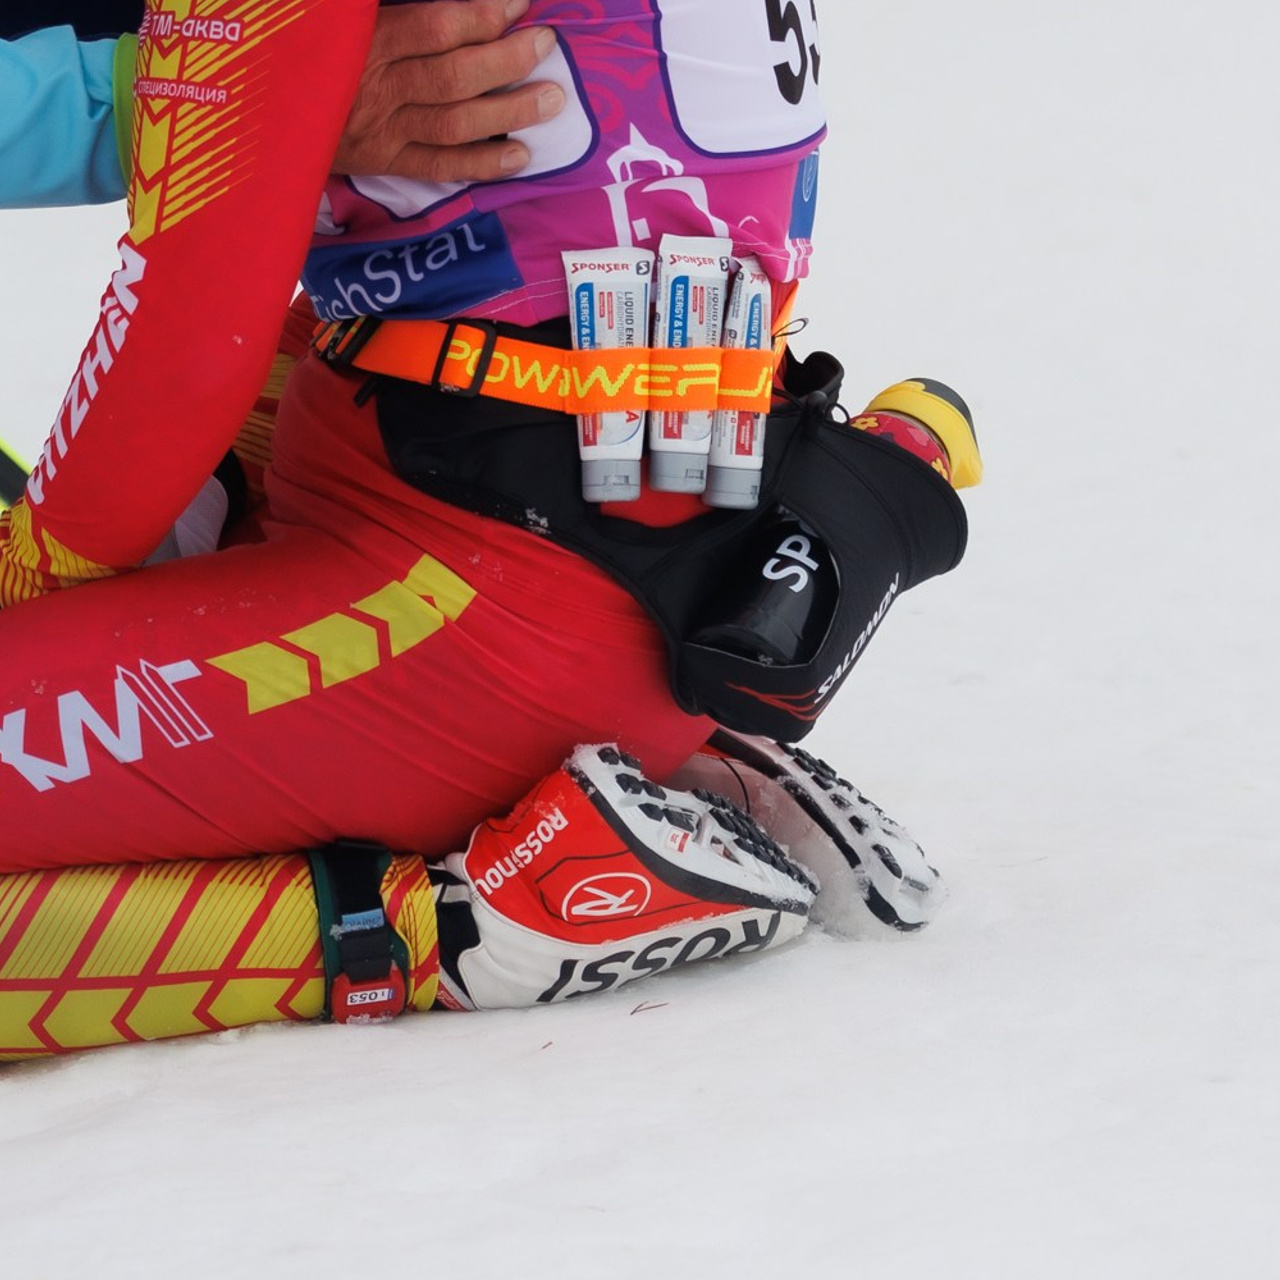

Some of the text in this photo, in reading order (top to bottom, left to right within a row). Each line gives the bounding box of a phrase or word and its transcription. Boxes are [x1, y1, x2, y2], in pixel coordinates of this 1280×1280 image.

[571, 262, 631, 274] SPONSER
[670, 254, 716, 267] SPONSER
[675, 284, 685, 319] ENERGY
[711, 287, 719, 322] LIQUID
[579, 291, 591, 349] ENERGY & EN
[624, 291, 634, 348] LIQUID ENE
[675, 321, 684, 332] &
[762, 533, 819, 593] SP
[813, 572, 900, 704] SALOMON
